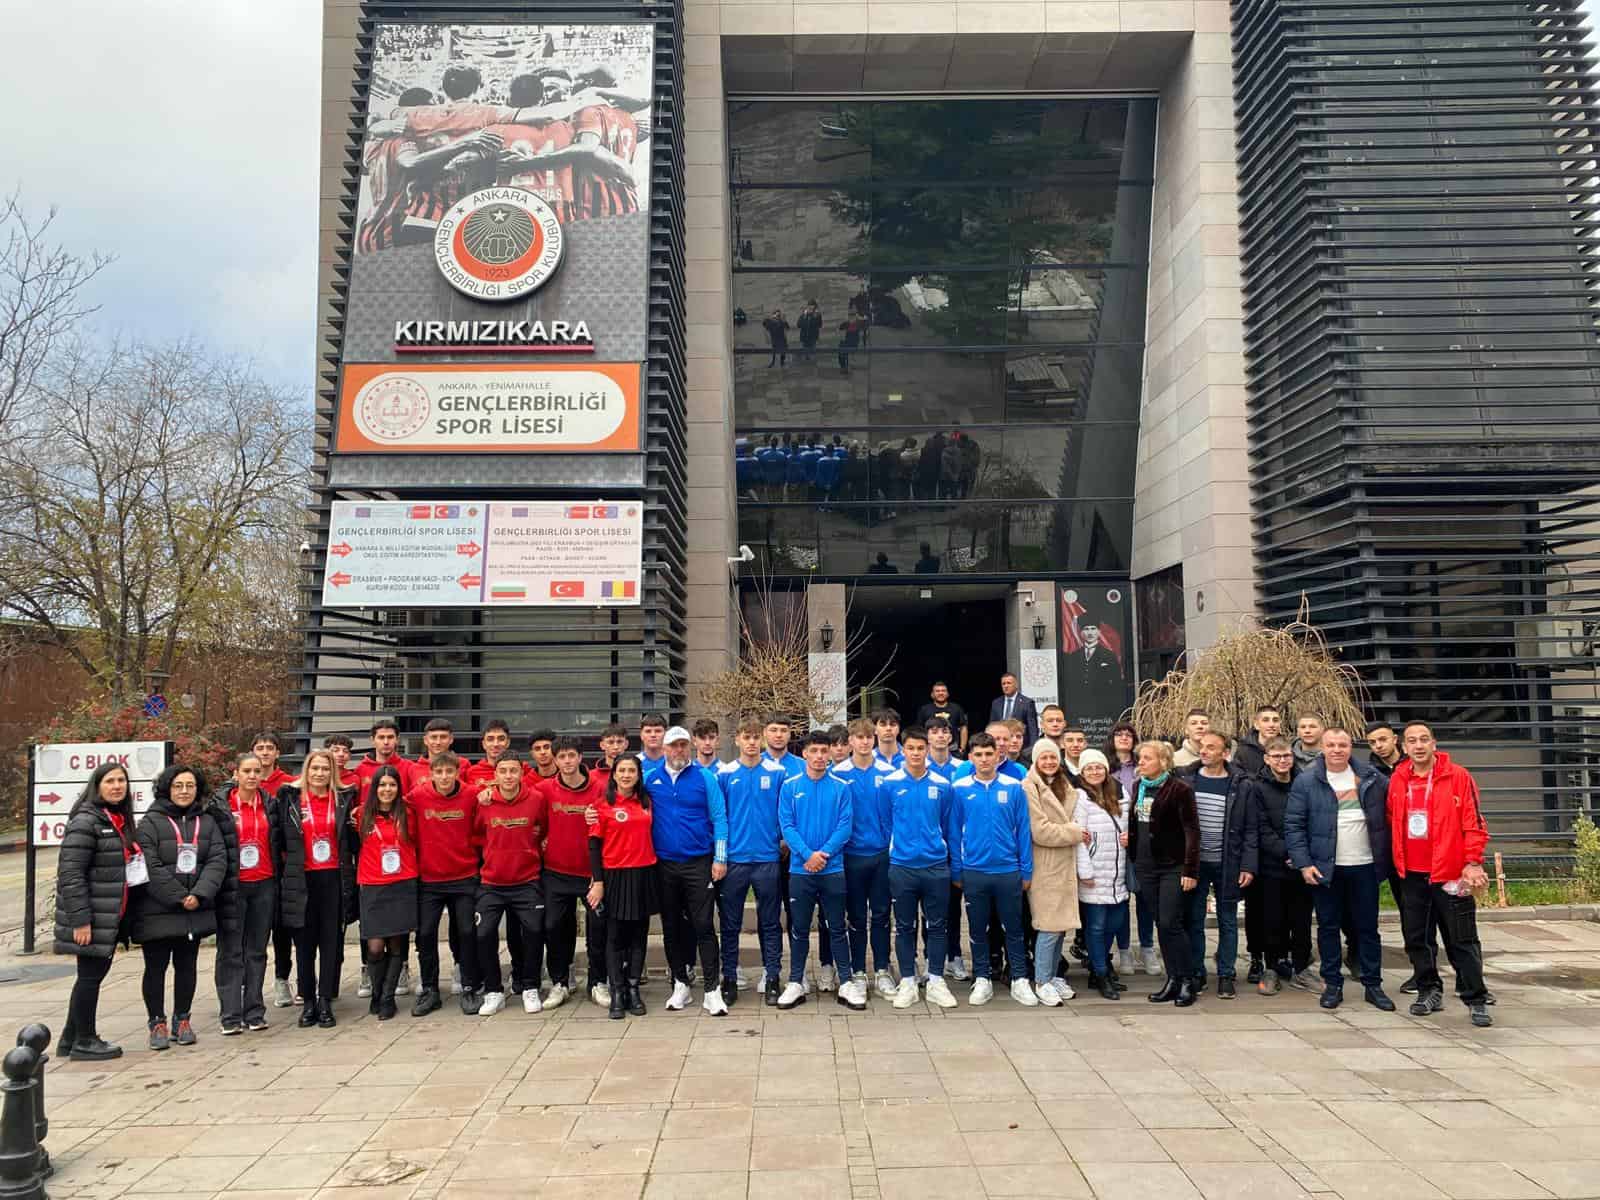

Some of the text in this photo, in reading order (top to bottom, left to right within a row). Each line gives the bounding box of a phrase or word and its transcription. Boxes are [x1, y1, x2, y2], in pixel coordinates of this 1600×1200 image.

[473, 190, 528, 205] ANKARA
[485, 267, 511, 279] 1923
[508, 268, 545, 294] SPOR
[394, 320, 593, 344] KIRMIZIKARA
[438, 383, 478, 392] ANKARA
[438, 391, 607, 415] GENÇLERBİRLİĞİ
[435, 415, 564, 435] SPOR LİSESİ
[418, 527, 444, 536] SPOR
[574, 527, 600, 536] SPOR
[70, 755, 80, 770] C
